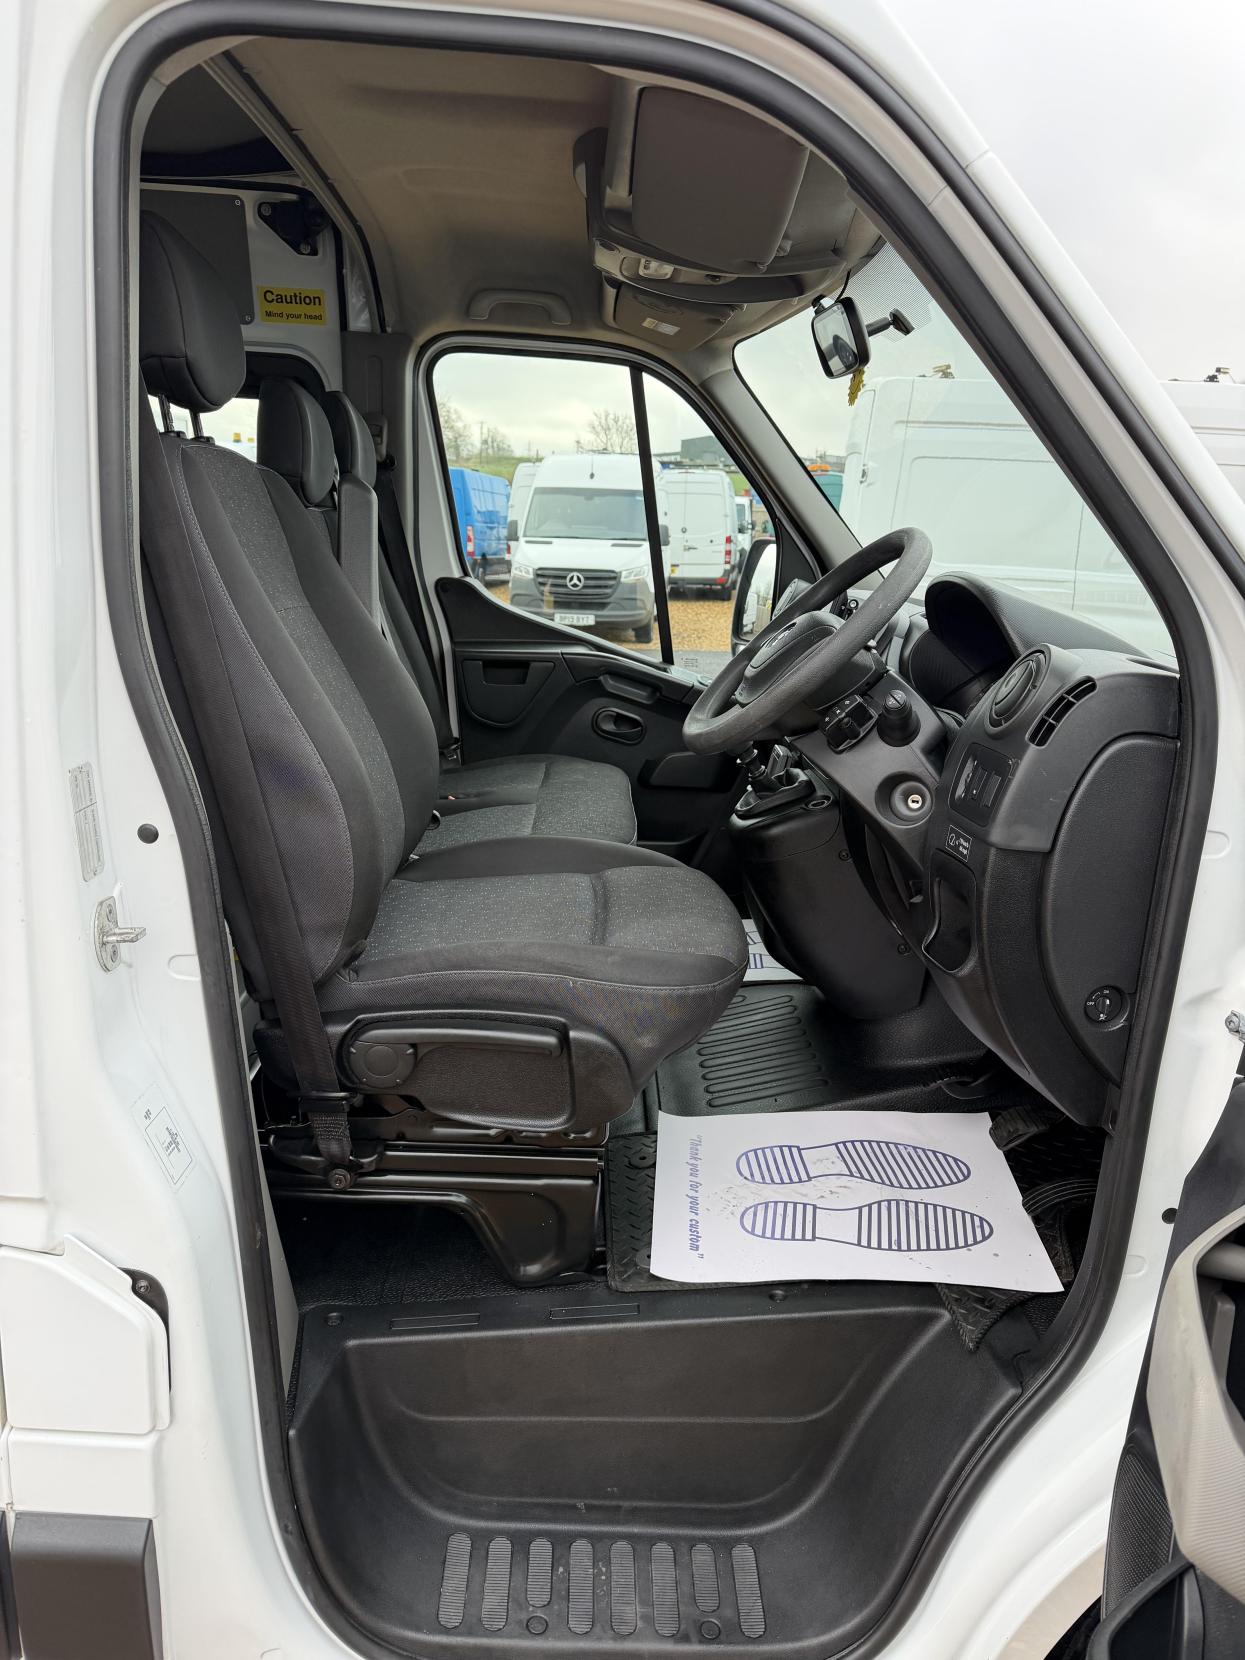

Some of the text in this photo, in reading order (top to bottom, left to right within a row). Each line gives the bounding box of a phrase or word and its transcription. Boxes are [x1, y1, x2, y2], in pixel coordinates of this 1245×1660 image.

[263, 290, 322, 306] Caution
[265, 310, 323, 321] Mind your head
[685, 1161, 700, 1178] you
[689, 1179, 703, 1193] for
[685, 1193, 700, 1216] your
